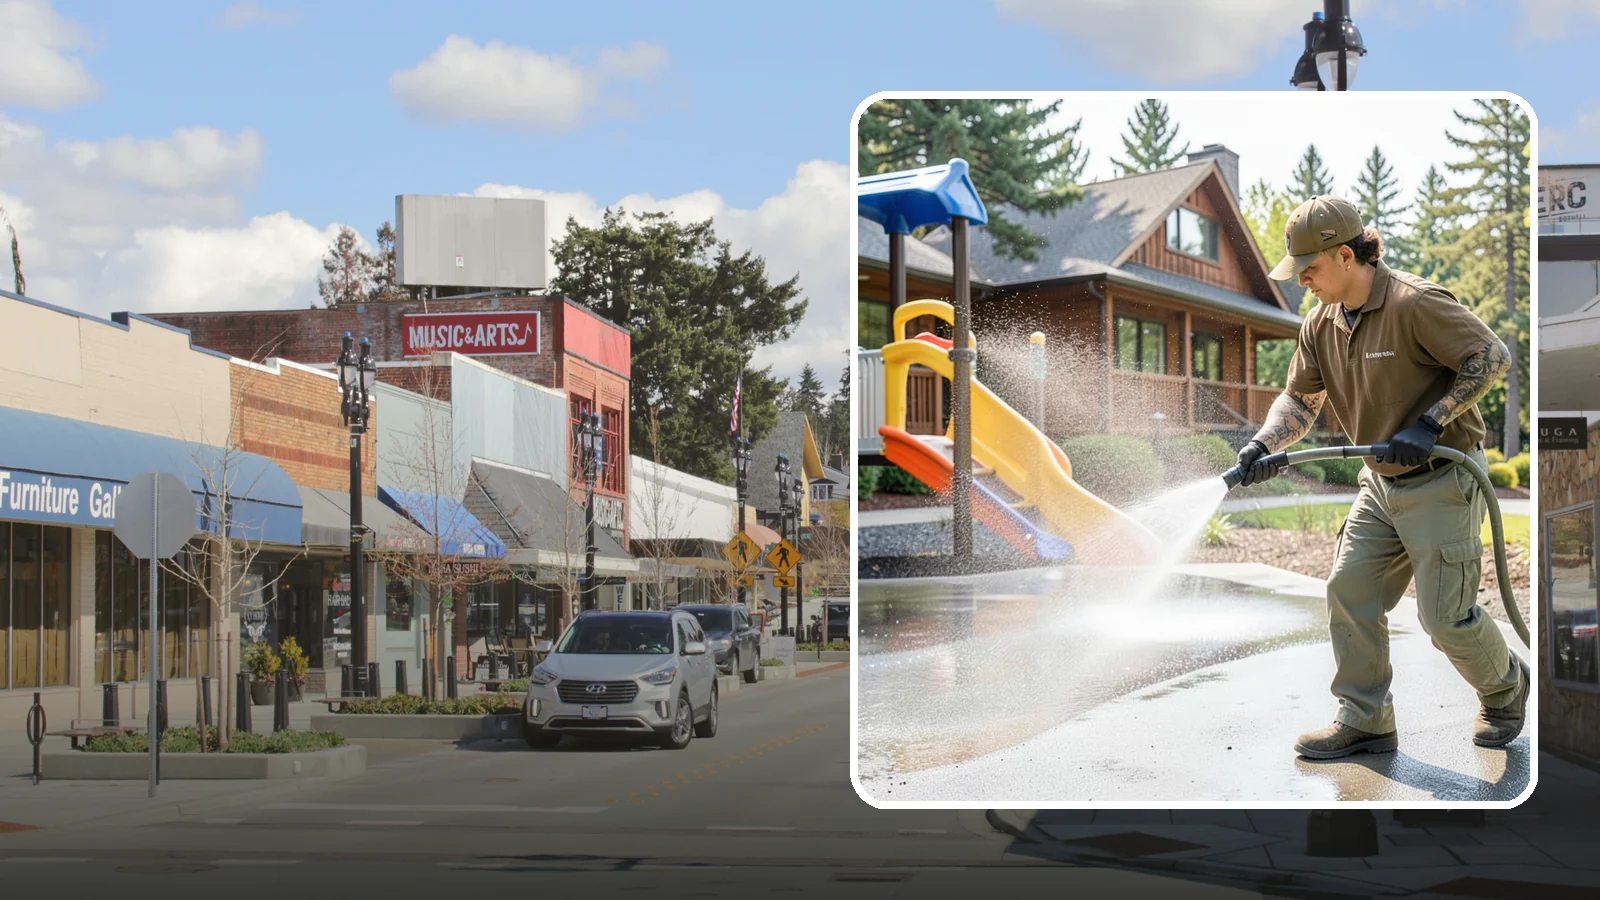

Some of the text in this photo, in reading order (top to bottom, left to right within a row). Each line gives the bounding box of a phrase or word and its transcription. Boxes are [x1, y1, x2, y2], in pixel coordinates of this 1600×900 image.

[1538, 181, 1586, 213] ERC
[409, 322, 520, 349] MUSIC&ARTS
[1540, 427, 1577, 436] UGA
[0, 471, 122, 519] Furniture Gal
[453, 562, 480, 575] SUSHI
